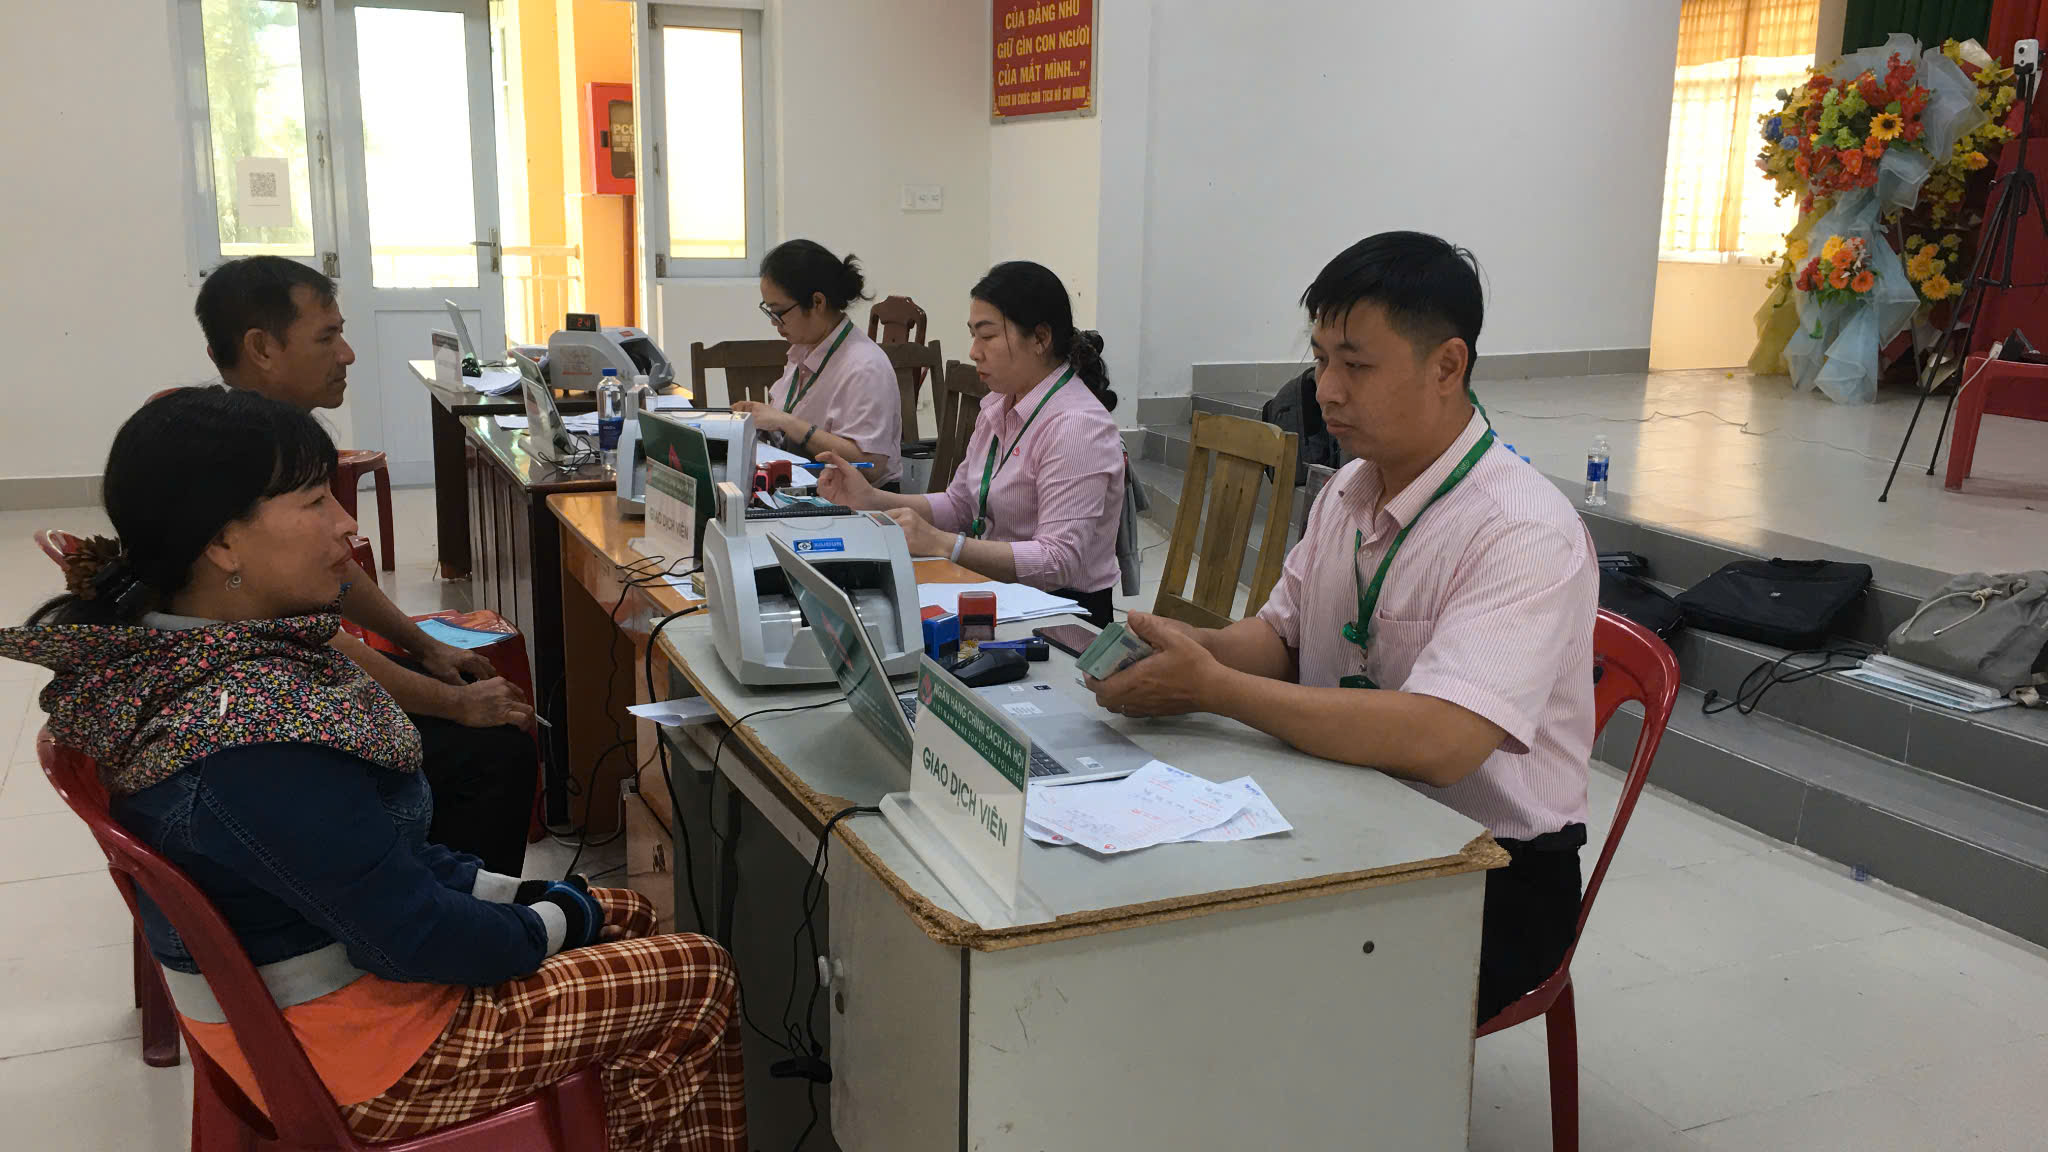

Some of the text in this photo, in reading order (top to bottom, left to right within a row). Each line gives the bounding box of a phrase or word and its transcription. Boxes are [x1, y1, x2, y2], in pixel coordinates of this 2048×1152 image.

[1005, 5, 1025, 30] CỦA
[1027, 1, 1056, 25] ĐẢNG
[997, 24, 1090, 59] GIỮ GÌN CON NGƯỜI
[998, 64, 1017, 87] CỦA
[933, 682, 1024, 769] NGÂN HÀNG CHÍNH SÁCH XÃ HỘI
[978, 740, 997, 763] SOCIAL
[997, 756, 1023, 786] POLICIES
[923, 747, 1008, 847] GIAO DỊCH VIÊN
